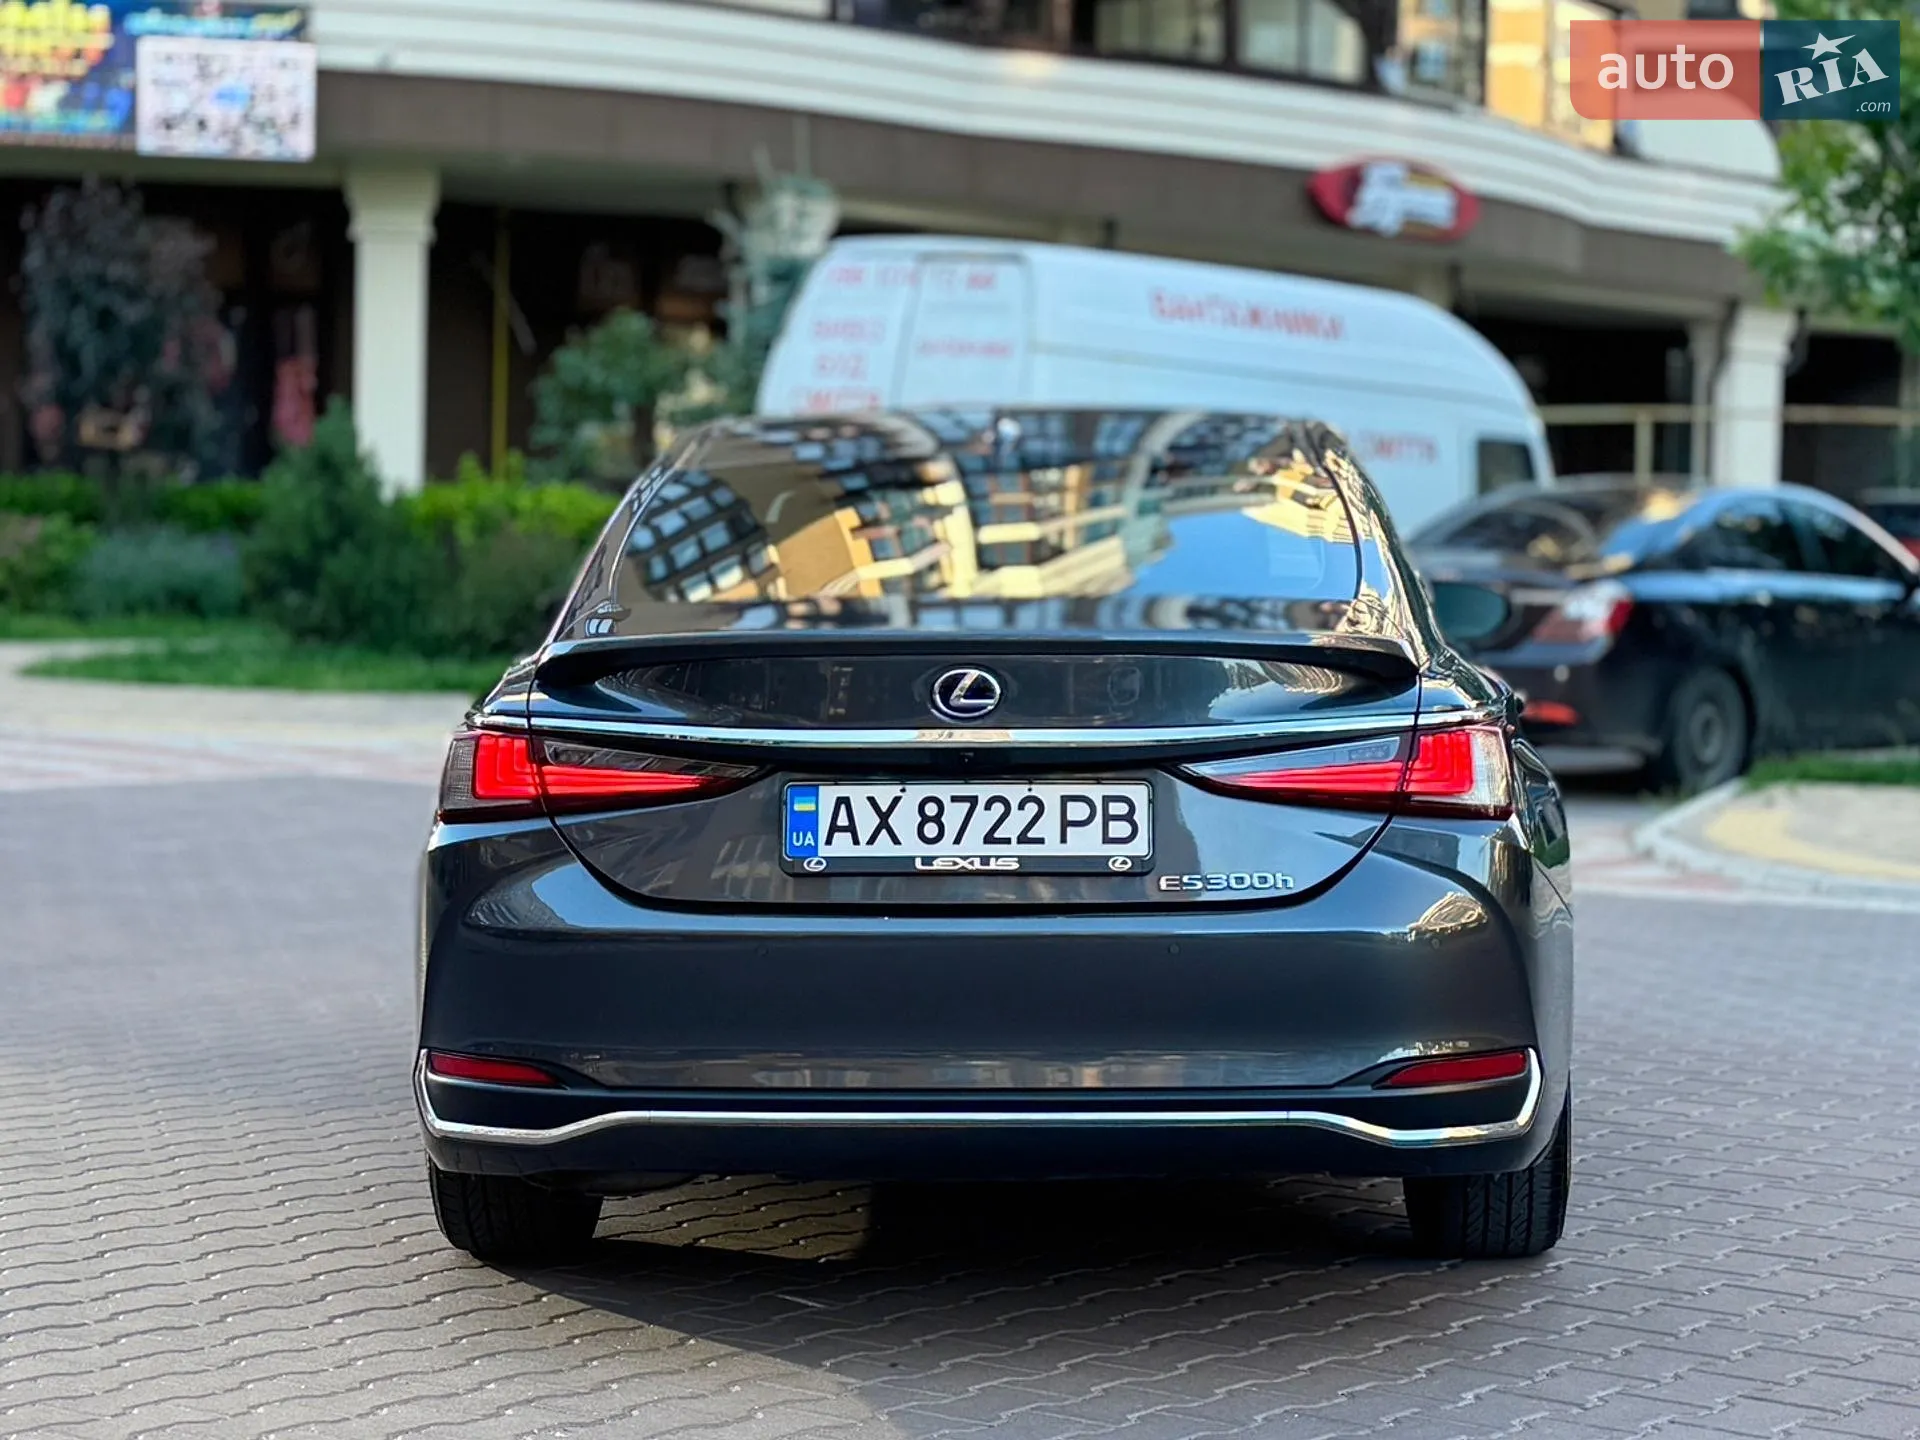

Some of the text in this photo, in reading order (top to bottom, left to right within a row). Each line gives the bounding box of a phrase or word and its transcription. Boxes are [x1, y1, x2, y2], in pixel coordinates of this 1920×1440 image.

[824, 795, 1139, 846] AX 8722 PB
[792, 831, 815, 846] UA
[914, 857, 1020, 870] LEXUS
